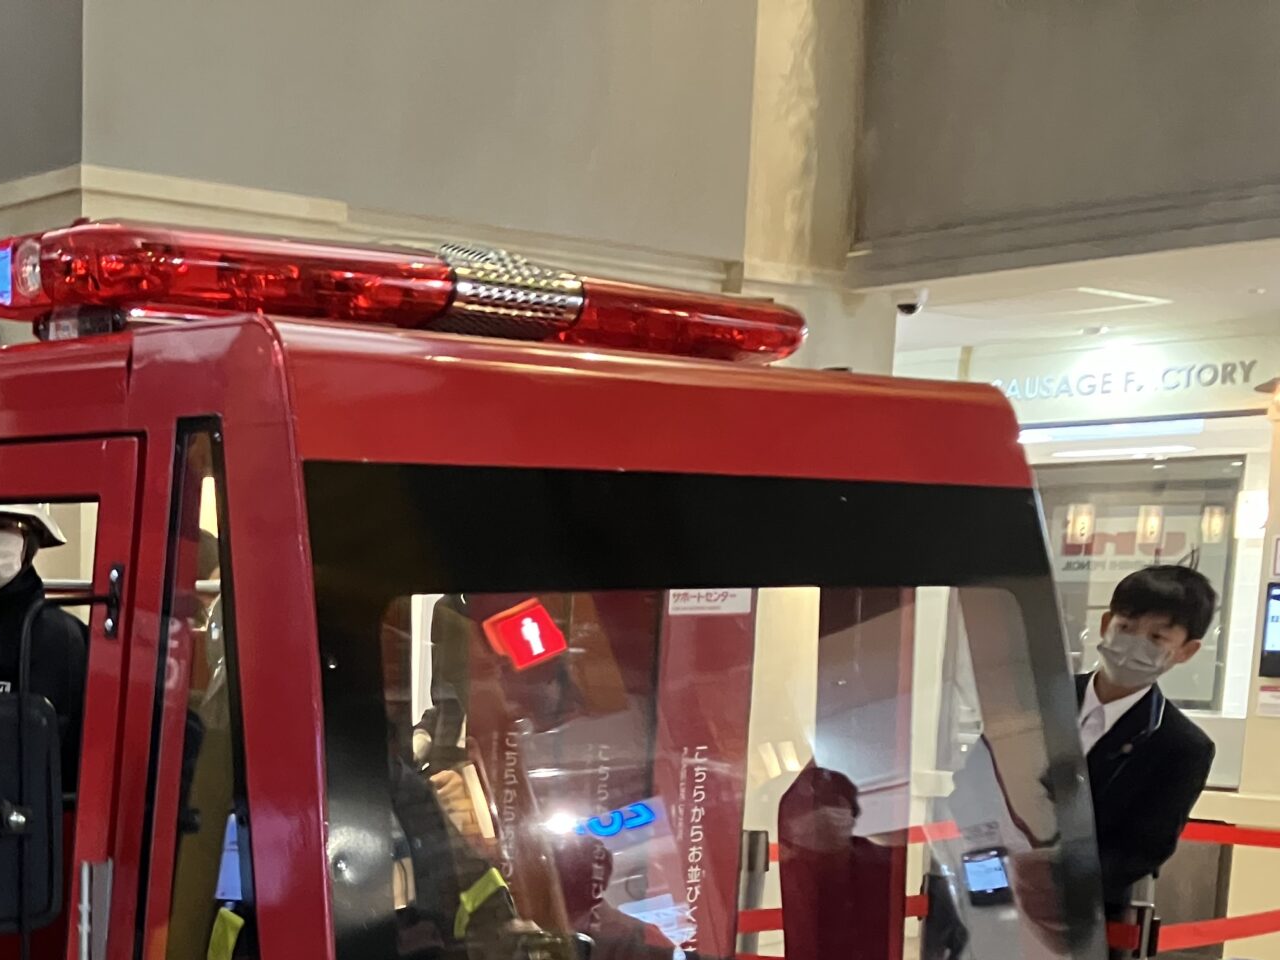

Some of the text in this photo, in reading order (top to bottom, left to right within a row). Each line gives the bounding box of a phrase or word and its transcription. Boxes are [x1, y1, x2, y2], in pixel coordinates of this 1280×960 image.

[1124, 359, 1258, 393] FCTORY
[672, 591, 737, 604] サポートセンター
